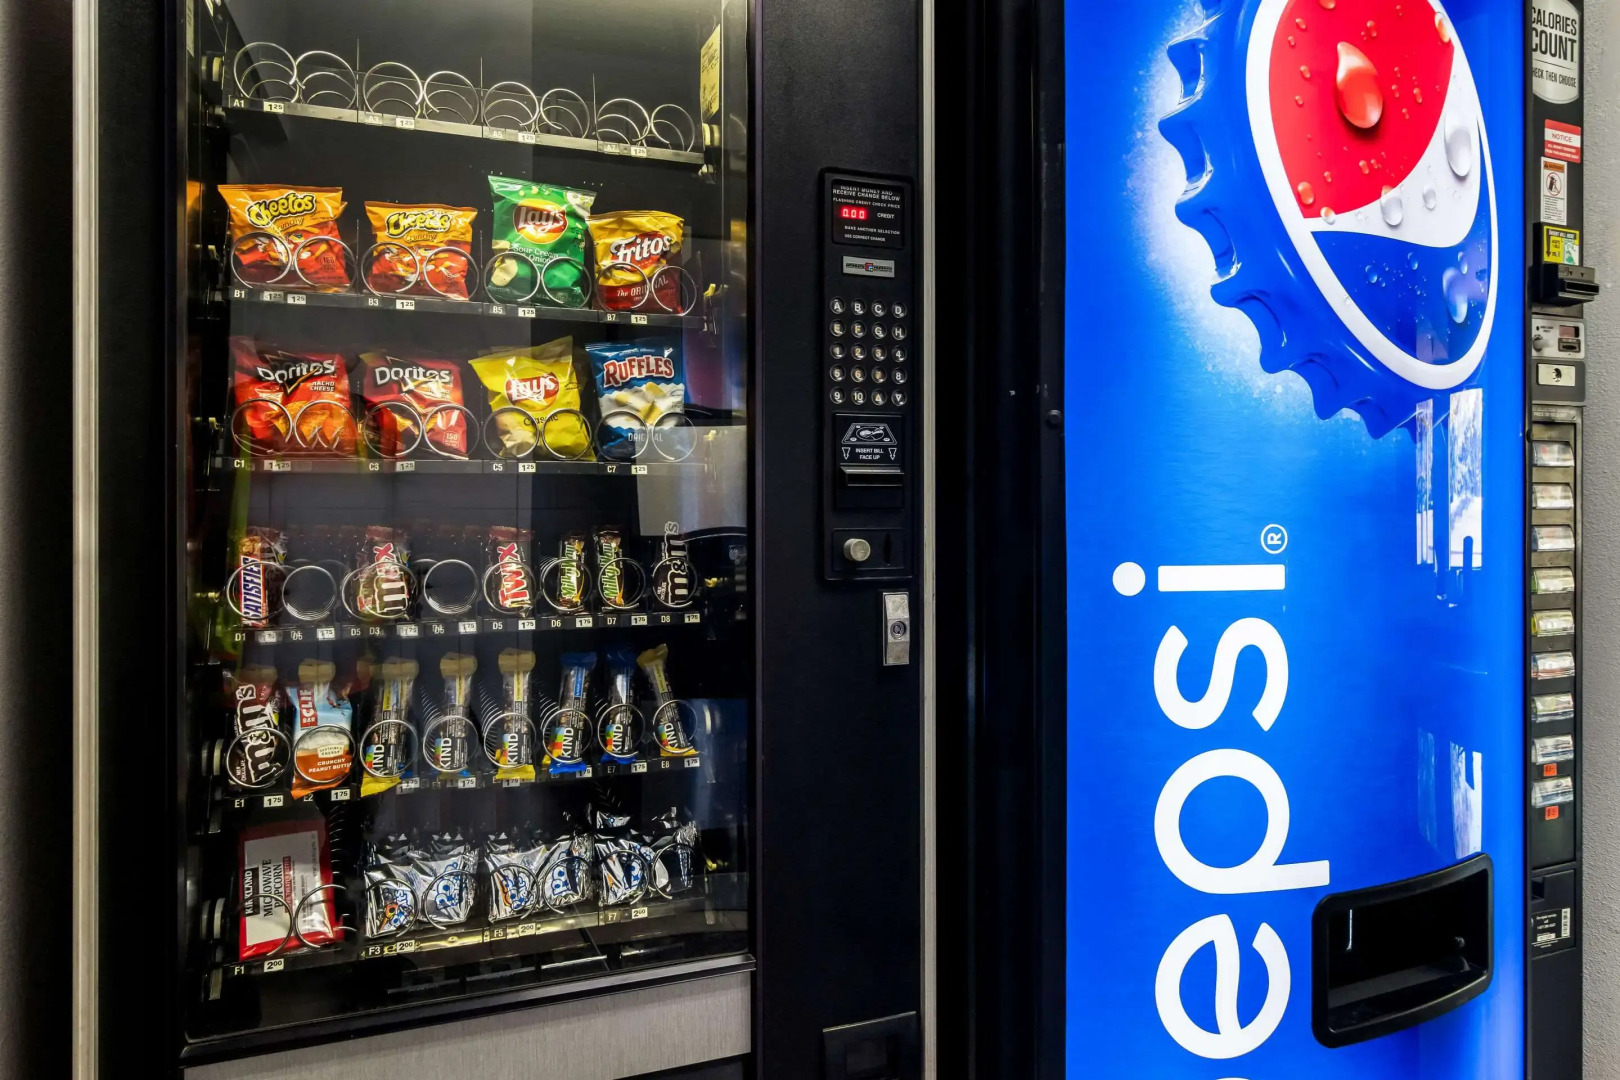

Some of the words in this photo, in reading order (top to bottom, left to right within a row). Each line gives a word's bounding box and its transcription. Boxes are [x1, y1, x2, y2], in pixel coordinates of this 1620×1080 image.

[1532, 67, 1544, 79] HECK
[233, 98, 245, 108] A1
[1552, 133, 1573, 142] NOTICE
[832, 189, 856, 197] RECEIVE
[857, 192, 880, 200] CHANGE
[248, 191, 316, 227] Cheetos
[517, 205, 566, 232] Lay's
[387, 211, 450, 236] Cheetos
[610, 235, 672, 264] Fritos
[234, 290, 245, 298] B1
[256, 359, 335, 384] Doritos
[375, 366, 451, 385] Doritos
[604, 355, 674, 388] RUFFLES
[510, 375, 557, 402] Lay's
[234, 460, 245, 468] C1
[369, 463, 379, 471] C3
[607, 465, 616, 473] C7
[242, 557, 262, 618] SATISFIES
[498, 543, 530, 609] TWIX
[235, 633, 246, 641] D1
[301, 689, 316, 717] CLIF
[508, 733, 519, 765] KIND
[562, 727, 574, 758] KIND
[611, 723, 623, 753] KIND
[317, 758, 346, 766] CRUNCHY
[440, 737, 452, 769] KIND
[308, 765, 331, 773] PEANUT
[244, 870, 254, 915] KIRKLAND
[262, 859, 273, 917] MICROWAVE
[272, 864, 283, 908] POPCORN
[608, 912, 617, 921] F7
[494, 928, 503, 937] F5
[369, 946, 380, 955] F3
[234, 967, 245, 975] F1
